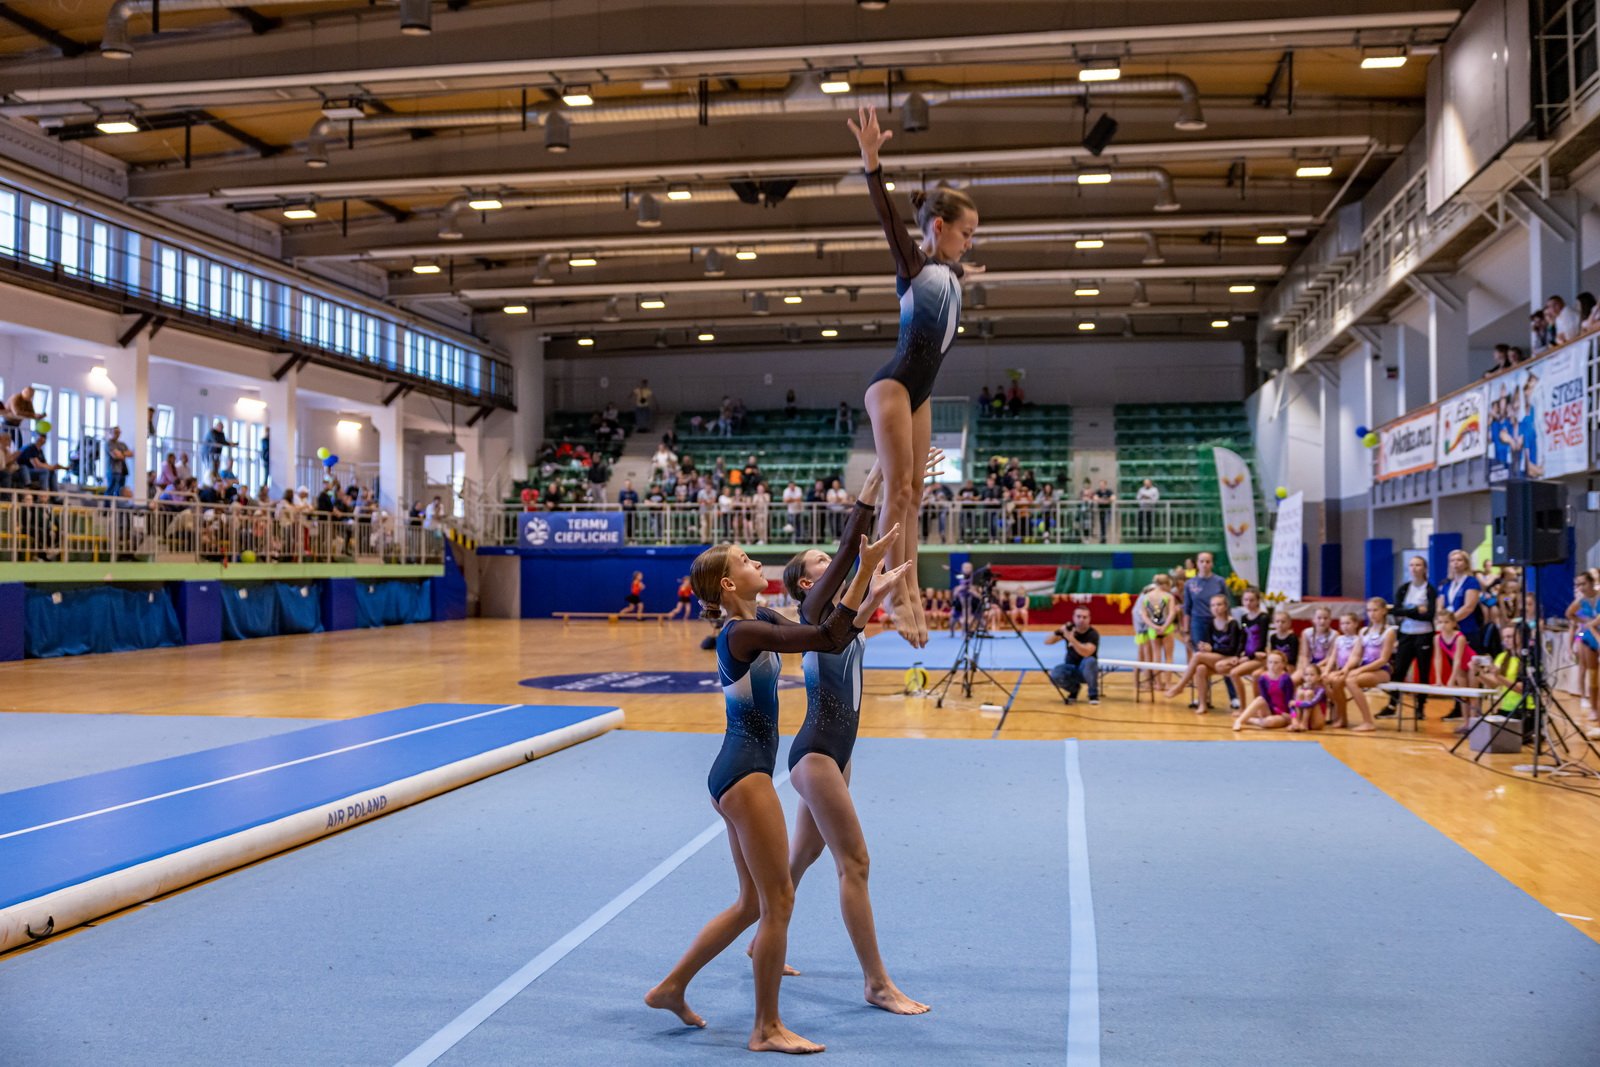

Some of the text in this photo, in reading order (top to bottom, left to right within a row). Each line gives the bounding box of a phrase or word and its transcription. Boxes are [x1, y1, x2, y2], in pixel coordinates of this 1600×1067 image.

[554, 531, 619, 543] CIEPLICKIE
[326, 795, 387, 829] AIR POLAND
